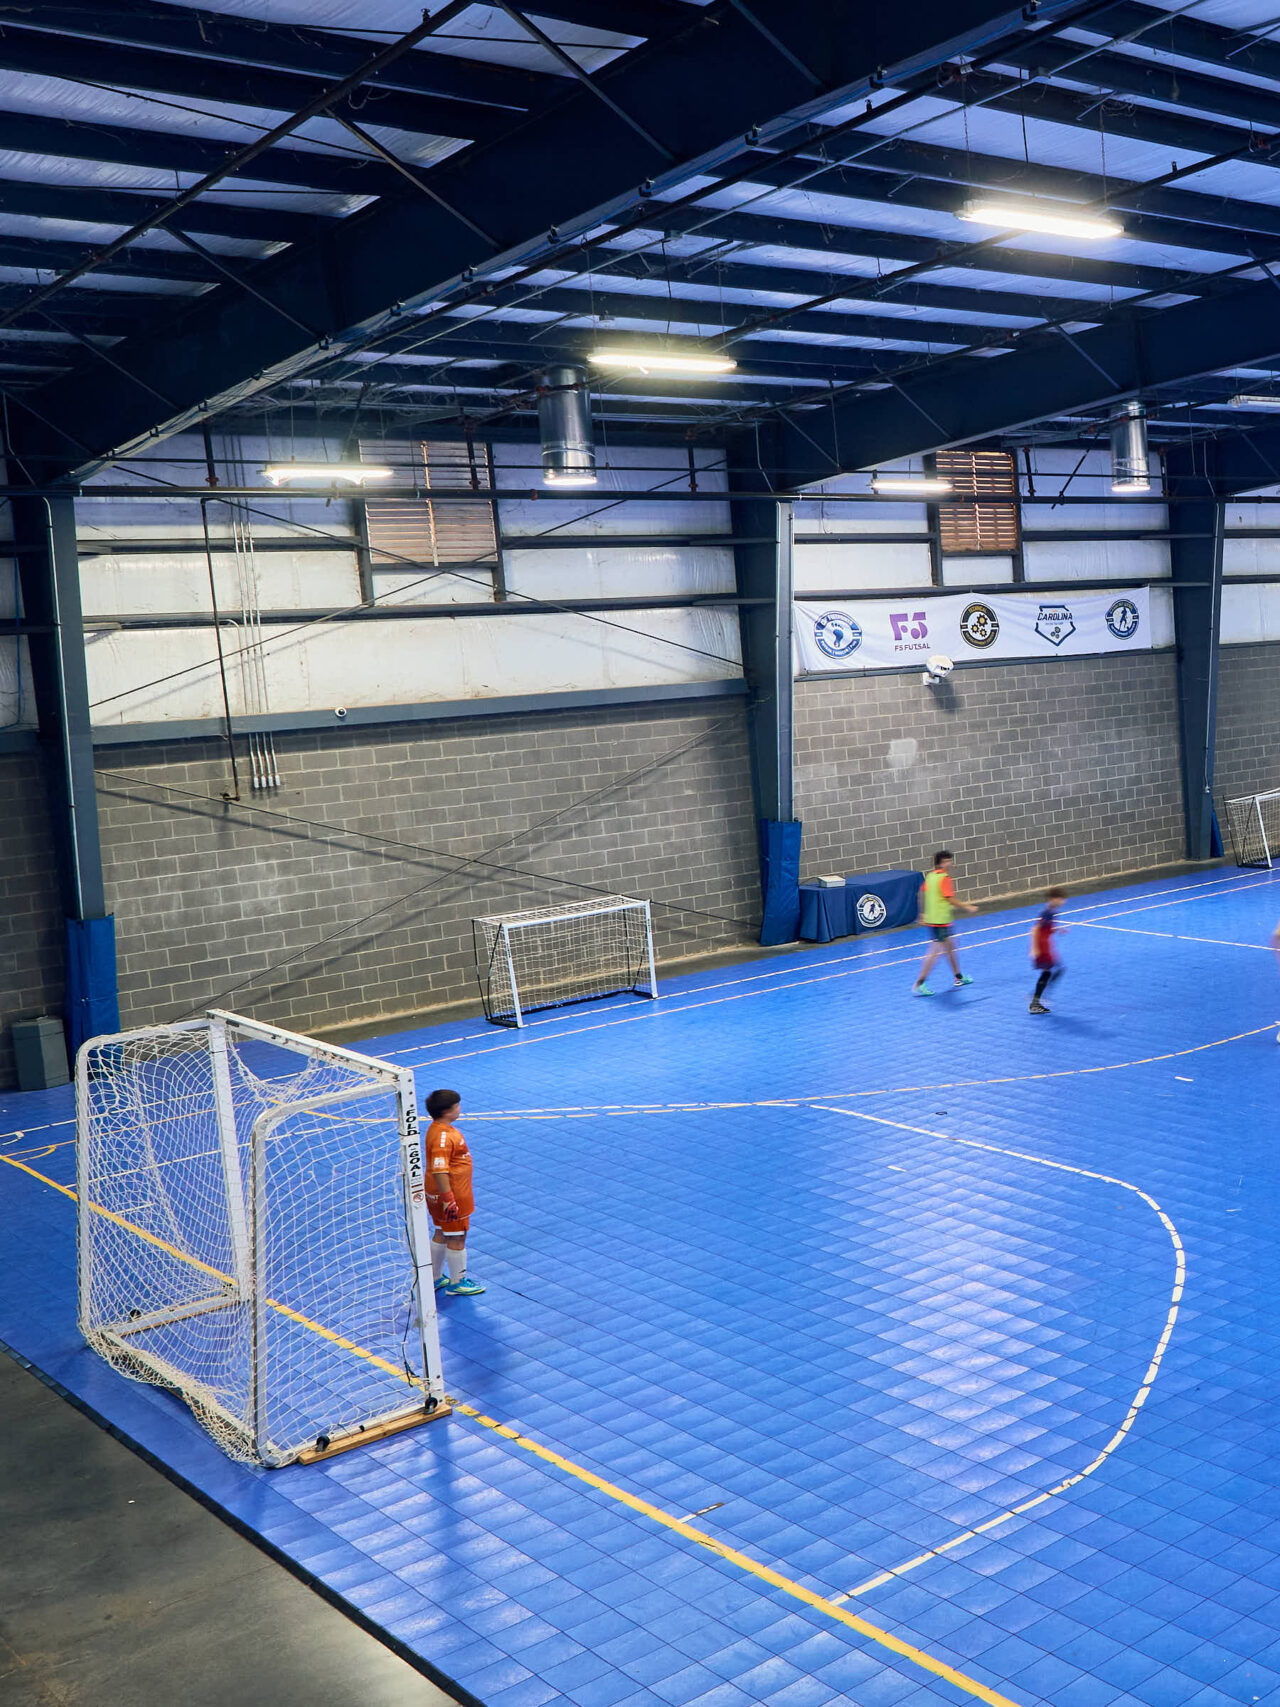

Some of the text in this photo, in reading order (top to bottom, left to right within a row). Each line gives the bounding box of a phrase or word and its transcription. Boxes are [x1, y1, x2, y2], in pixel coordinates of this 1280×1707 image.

[1037, 612, 1073, 621] CAROLINA
[904, 643, 931, 651] FUTSAL
[405, 1109, 418, 1136] FOLD
[409, 1150, 421, 1177] GOAL
